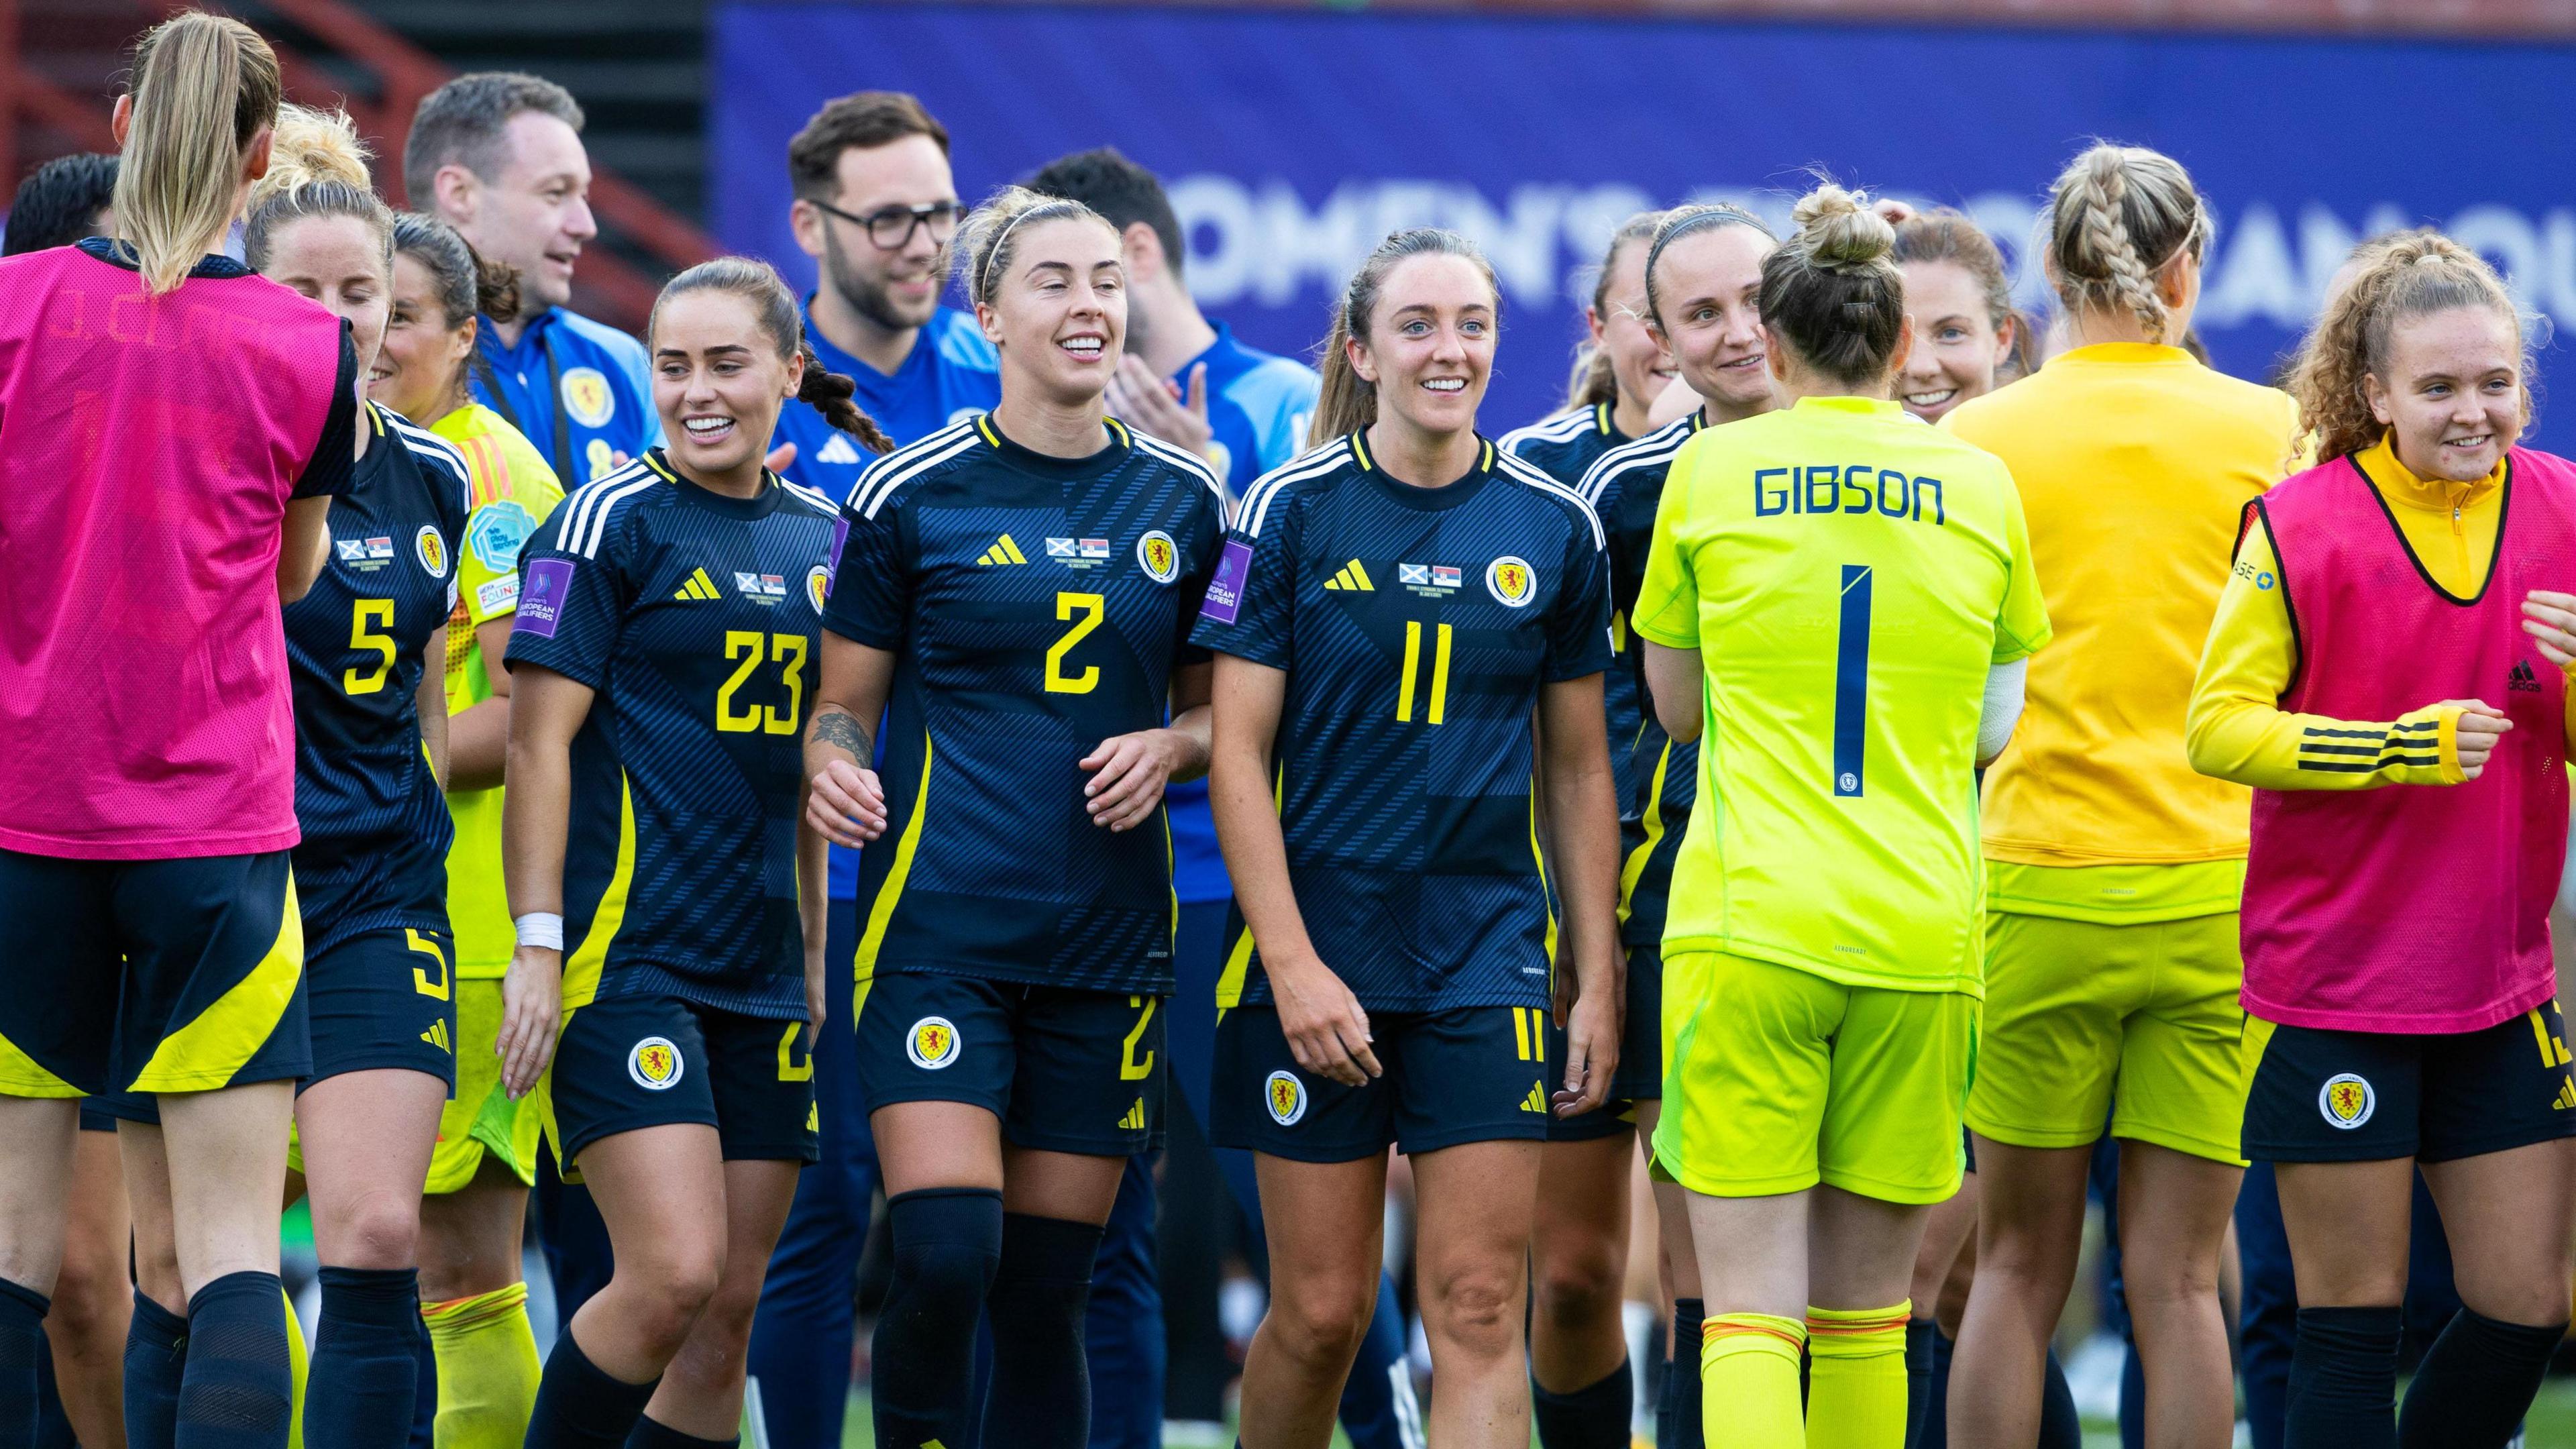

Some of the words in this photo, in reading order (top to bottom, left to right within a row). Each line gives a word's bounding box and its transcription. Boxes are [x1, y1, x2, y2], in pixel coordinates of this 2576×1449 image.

[1755, 465, 1945, 526] GIBSON
[481, 584, 520, 604] FOUND
[1044, 591, 1104, 694] 2
[343, 598, 397, 696] 5
[716, 631, 808, 735] 23
[1396, 621, 1453, 725] 11
[1834, 564, 1872, 797] 1
[2508, 679, 2542, 692] adidas
[1513, 1007, 1544, 1063] 11
